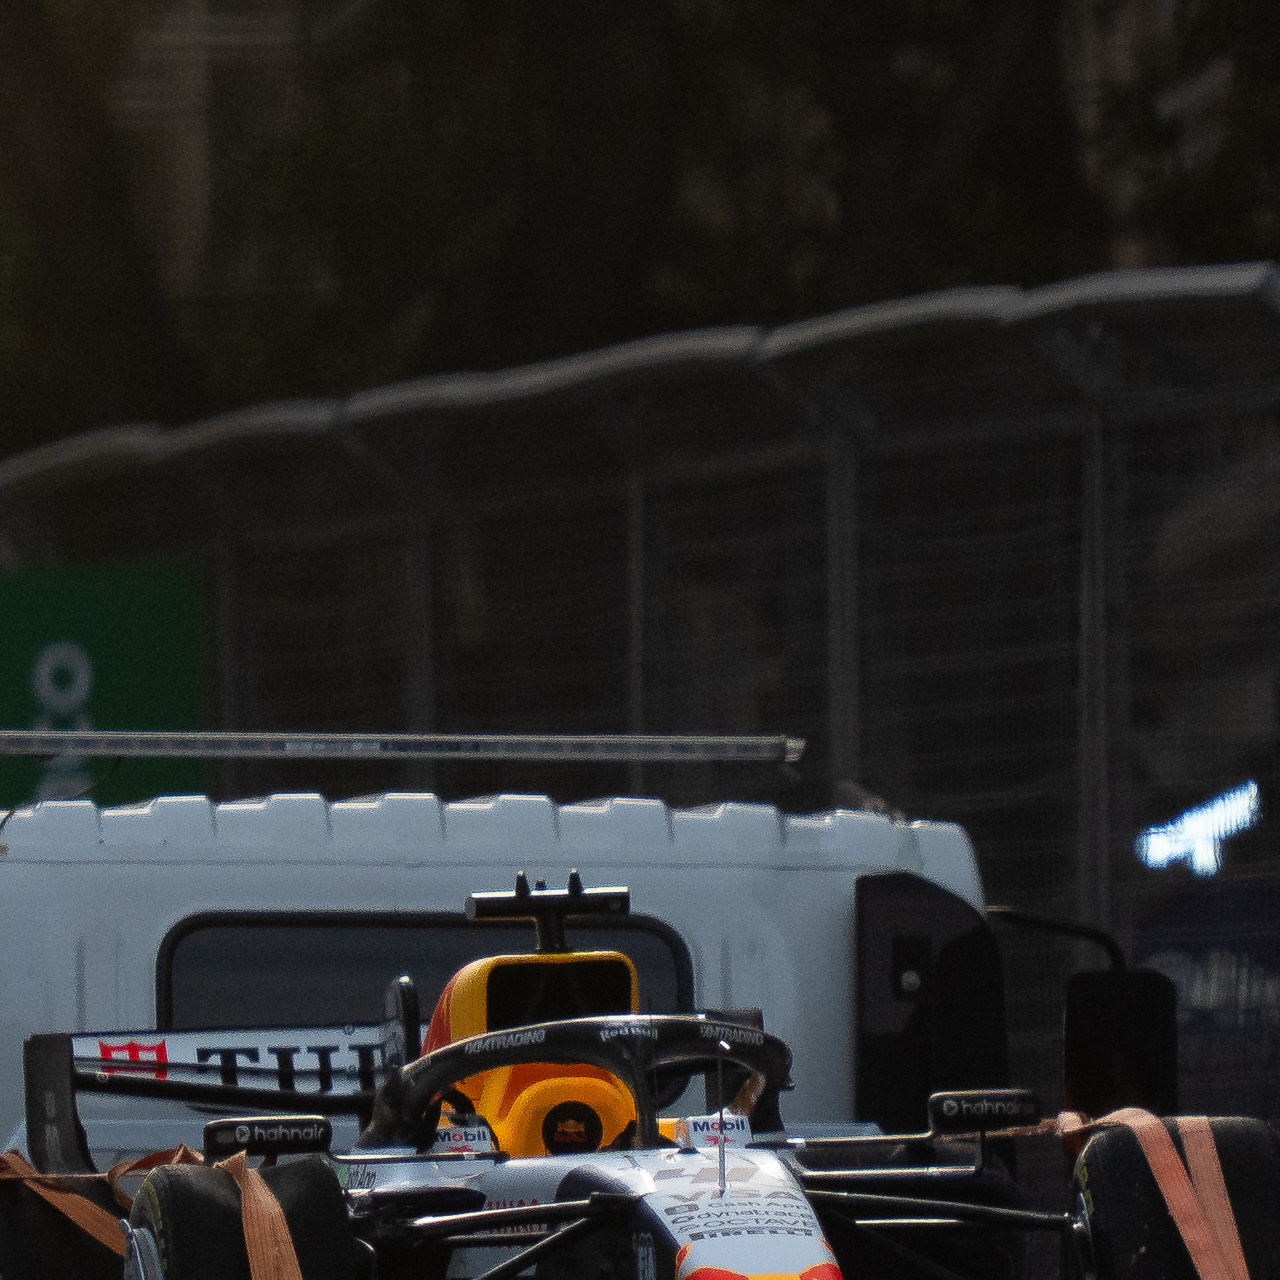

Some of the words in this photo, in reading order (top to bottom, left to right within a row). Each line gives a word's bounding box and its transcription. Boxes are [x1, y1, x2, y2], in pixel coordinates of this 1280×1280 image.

[254, 1124, 325, 1141] hahnair
[693, 1119, 745, 1133] Mobil
[436, 1127, 487, 1143] Mobil
[698, 1208, 815, 1221] dynatrace
